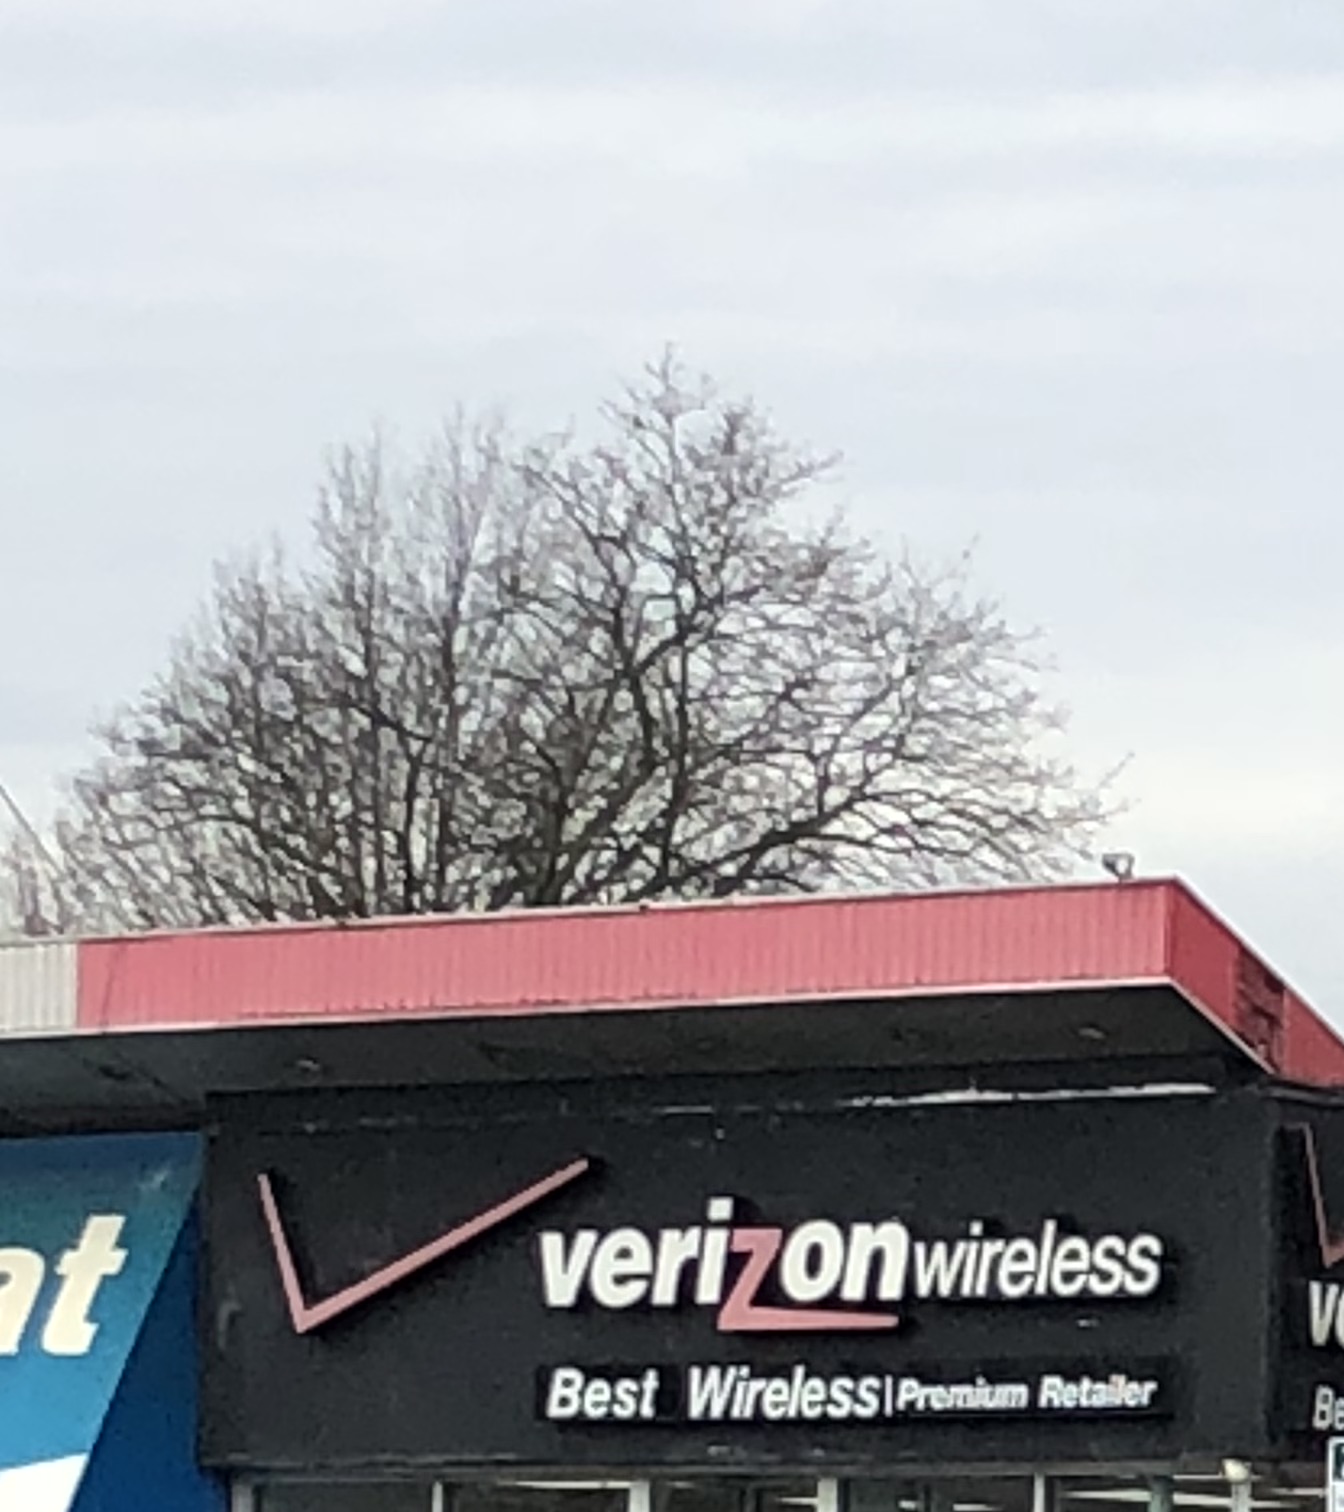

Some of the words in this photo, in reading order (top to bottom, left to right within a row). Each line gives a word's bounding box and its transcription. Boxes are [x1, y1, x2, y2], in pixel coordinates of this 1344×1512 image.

[538, 1197, 910, 1331] verizon
[913, 1219, 1163, 1299] wireless
[546, 1365, 659, 1419] Best
[688, 1363, 881, 1420] Wireless
[897, 1375, 1029, 1411] Premium
[1037, 1373, 1159, 1408] Retailer
